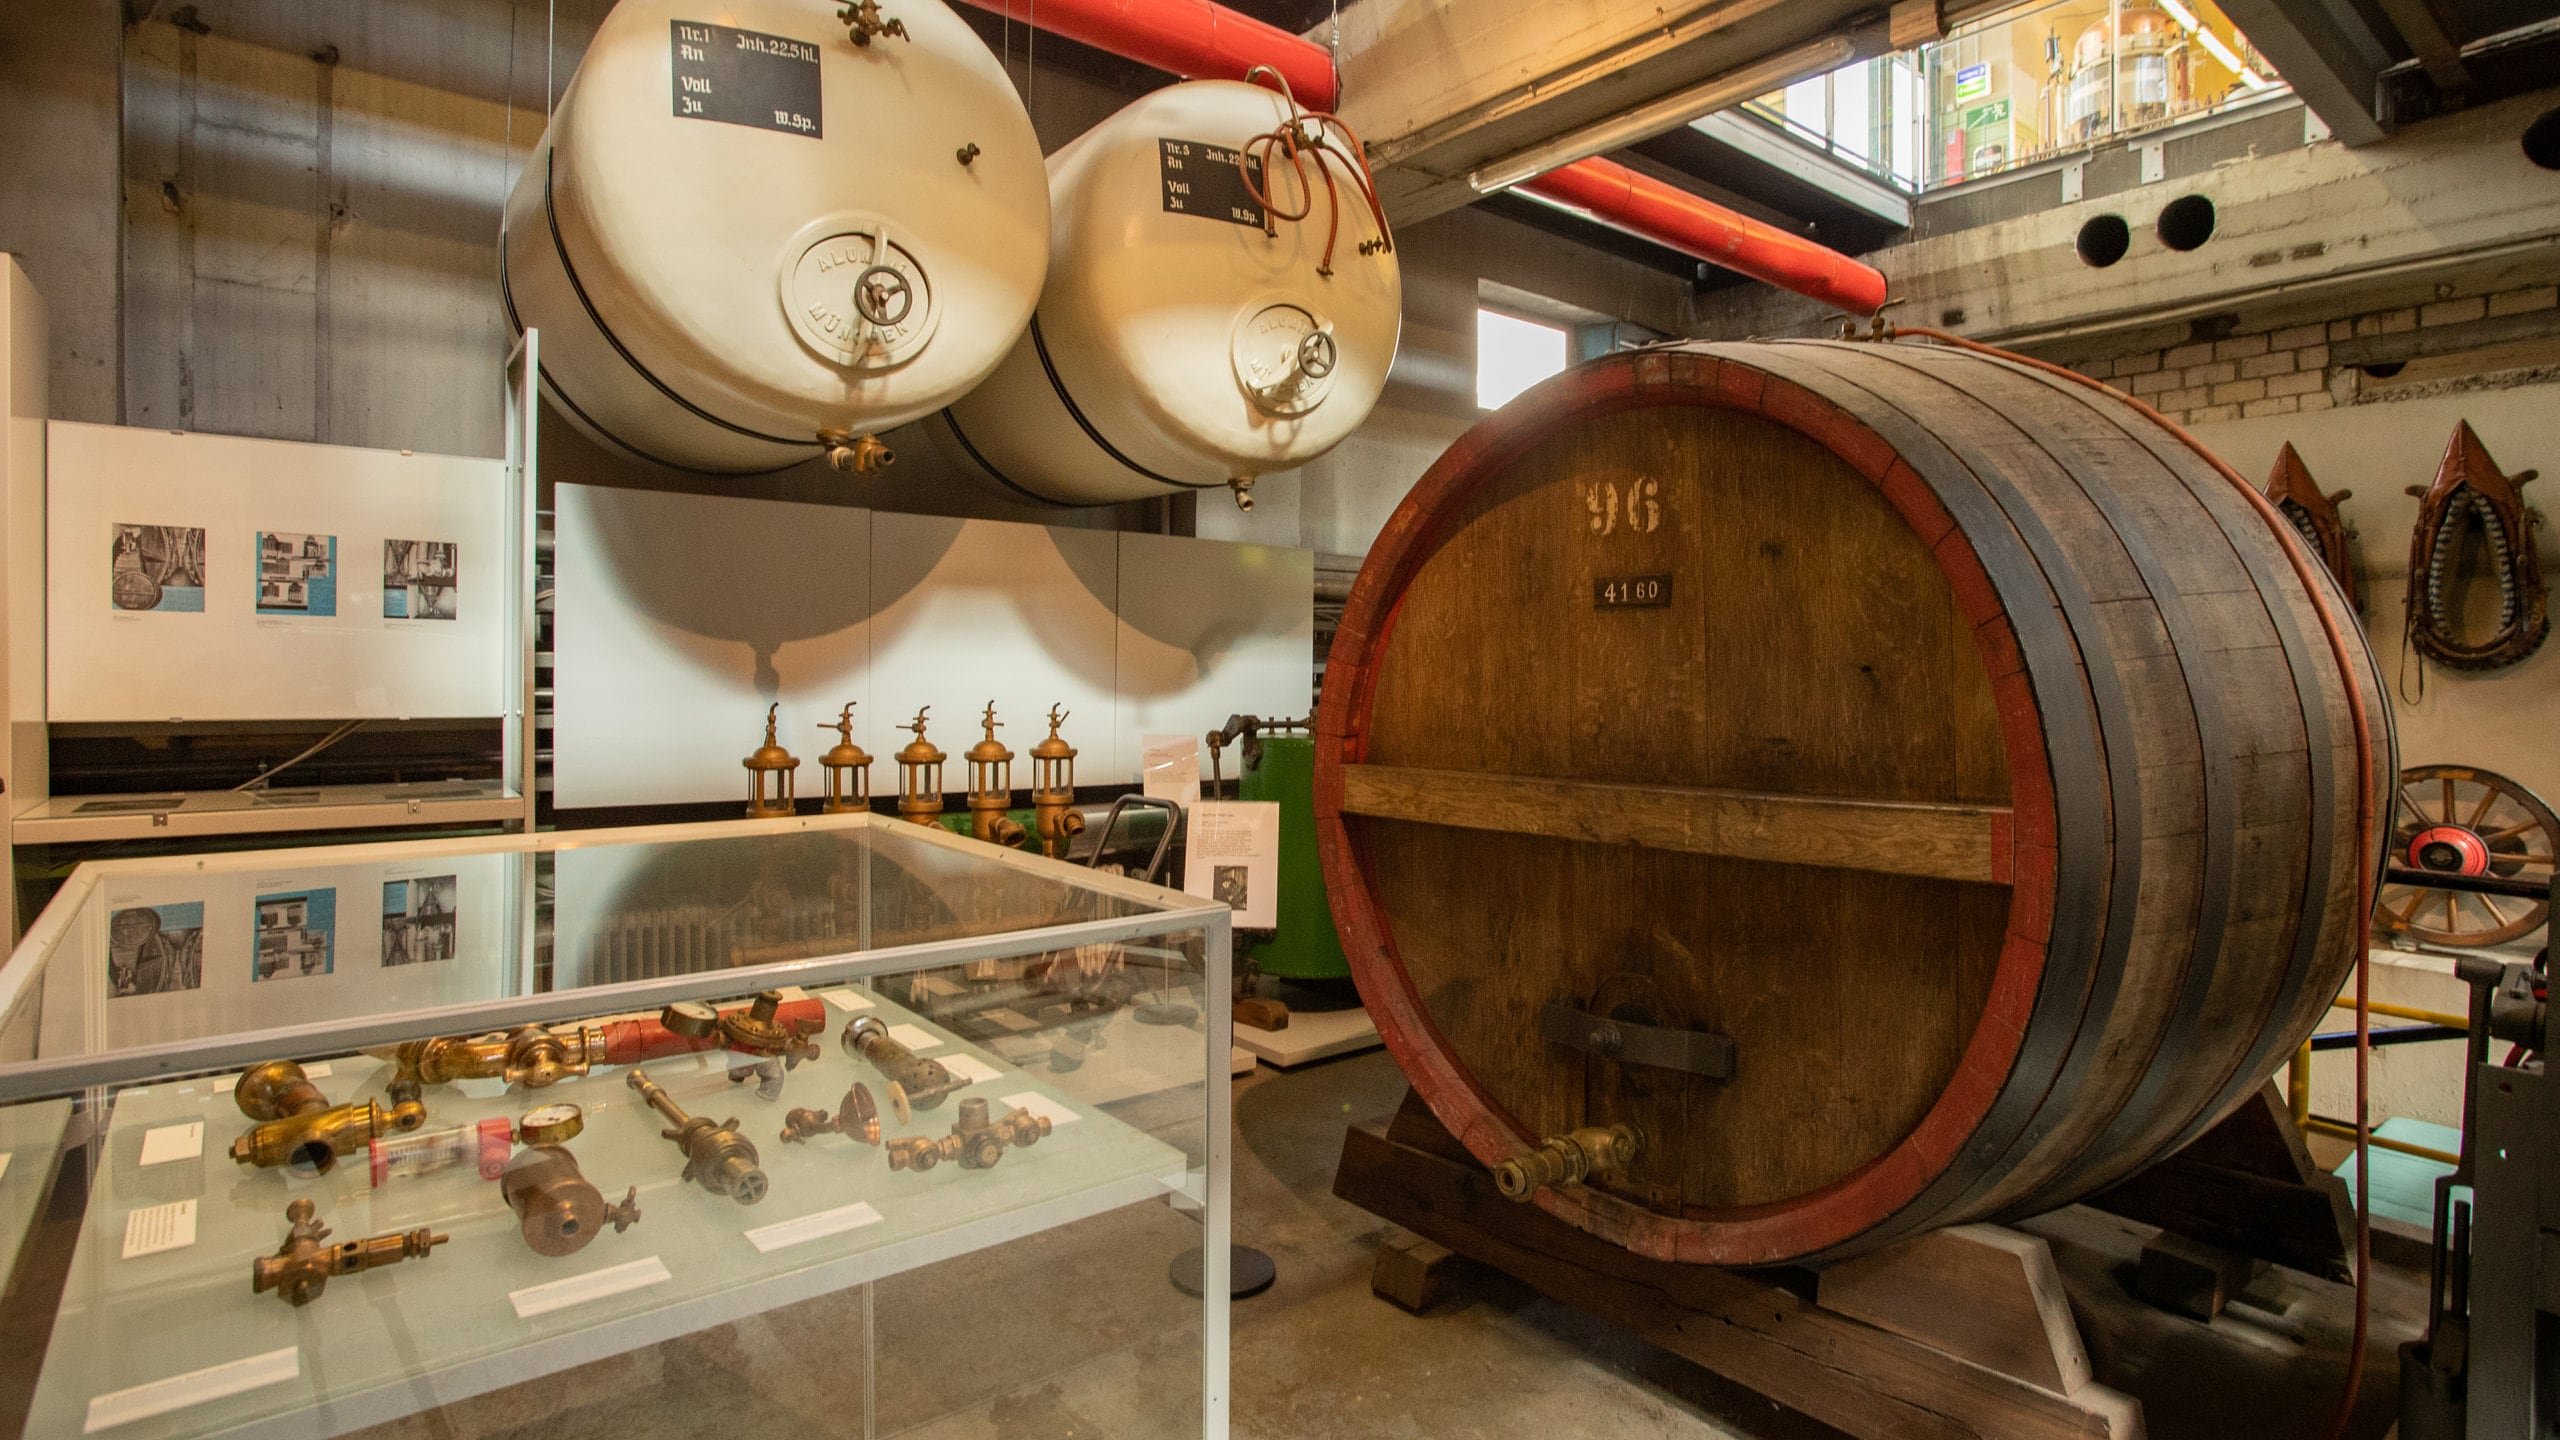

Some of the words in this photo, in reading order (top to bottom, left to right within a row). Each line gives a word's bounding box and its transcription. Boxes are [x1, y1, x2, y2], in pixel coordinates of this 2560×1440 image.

[681, 76, 712, 94] Voll
[1168, 181, 1190, 194] Voll
[1586, 475, 1660, 535] 96
[1604, 581, 1658, 603] 4160
